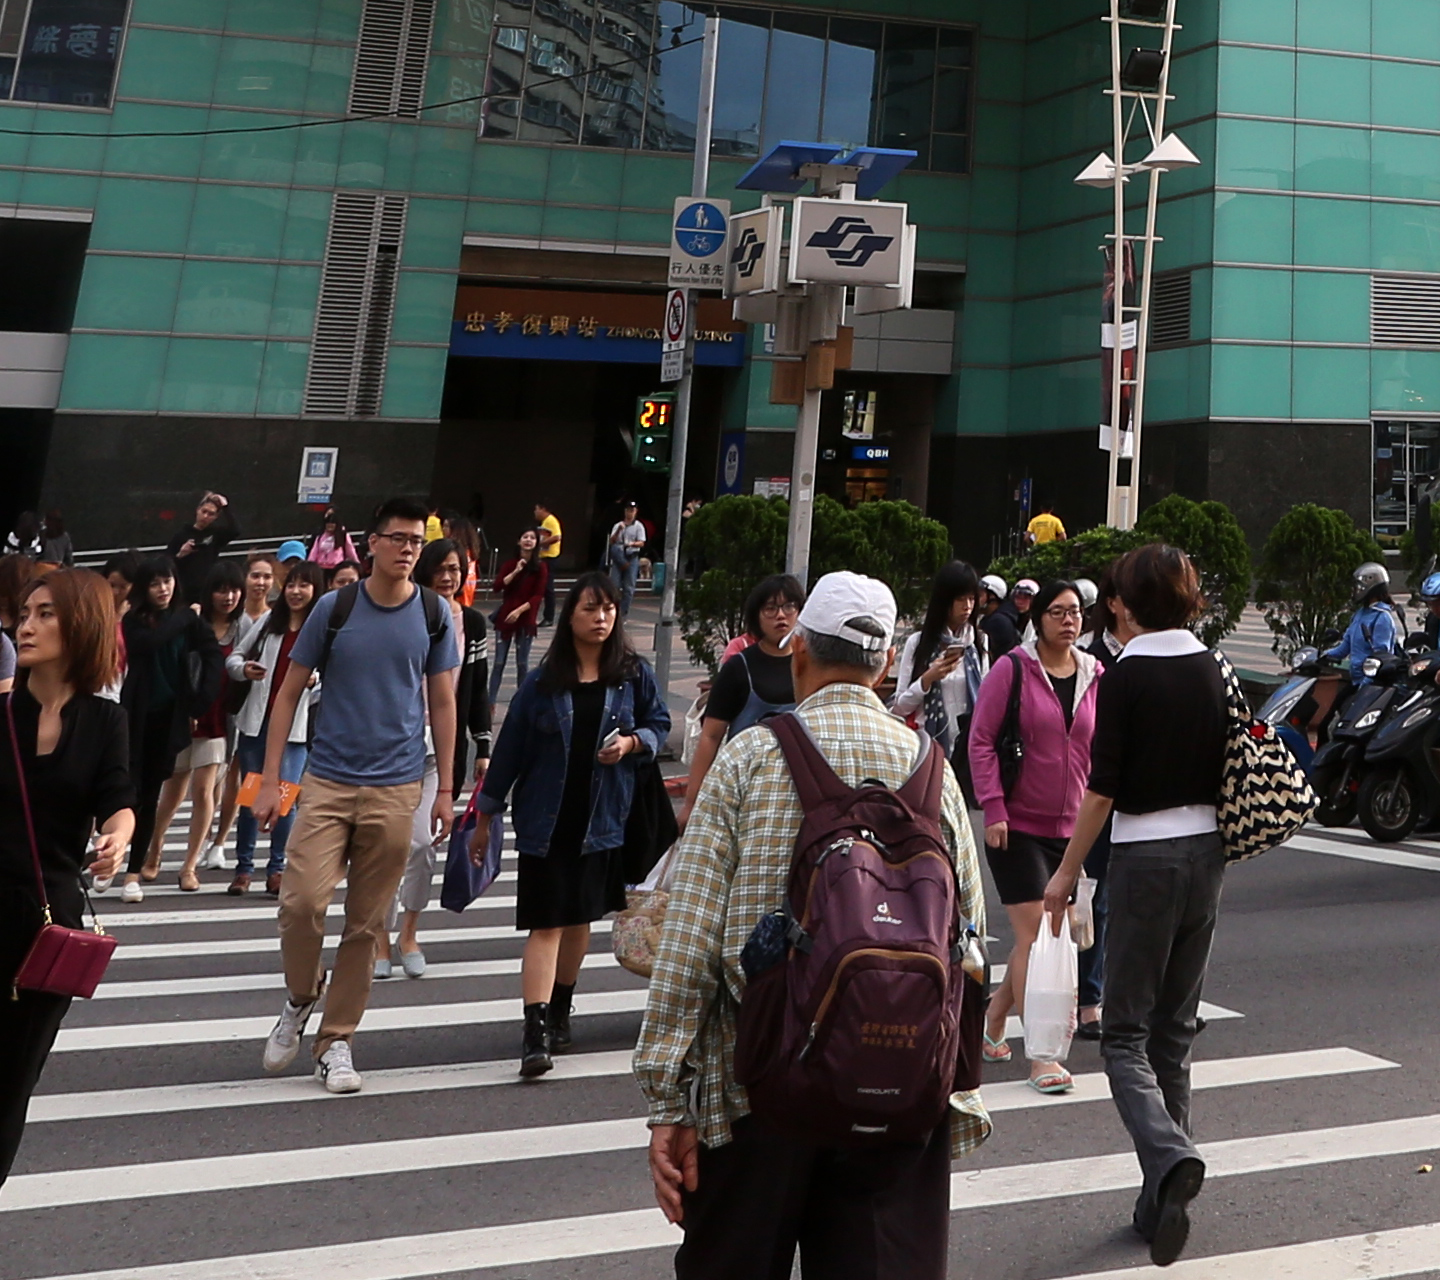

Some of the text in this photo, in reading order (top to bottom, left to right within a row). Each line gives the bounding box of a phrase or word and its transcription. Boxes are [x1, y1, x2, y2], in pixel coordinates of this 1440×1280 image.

[671, 262, 724, 276] 行人優先
[464, 311, 599, 338] 忠孝復興站
[606, 326, 733, 342] ZHONGX UXING
[639, 401, 670, 428] 21
